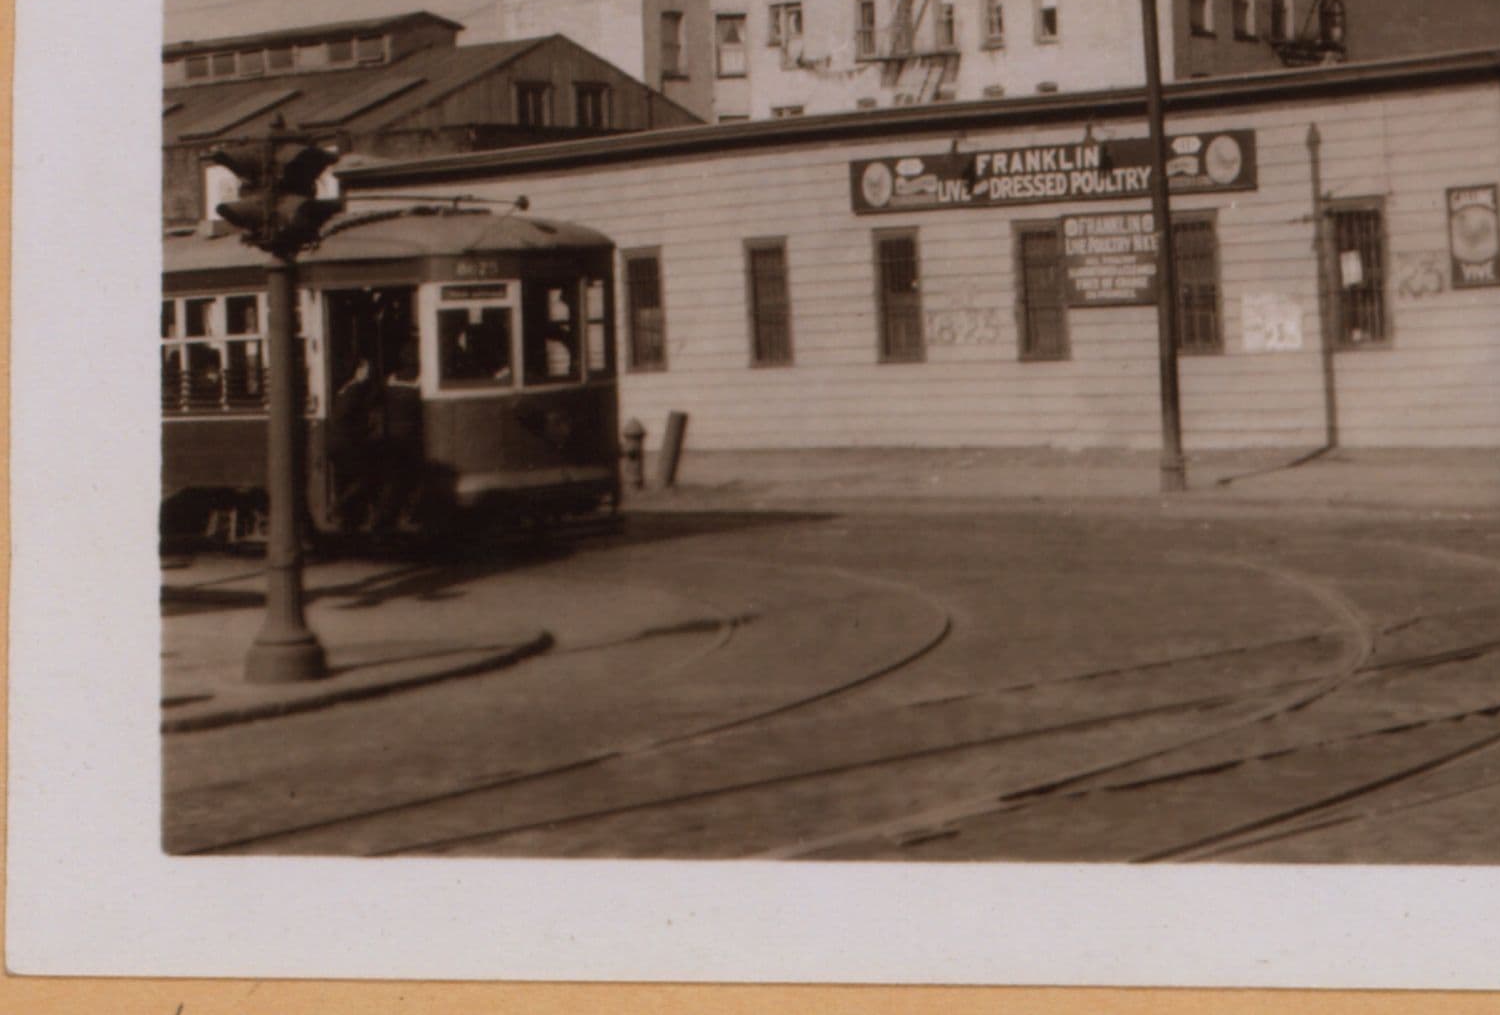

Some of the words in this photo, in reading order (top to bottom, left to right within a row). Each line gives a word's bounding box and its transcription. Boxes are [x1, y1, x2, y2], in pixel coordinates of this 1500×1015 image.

[975, 144, 1100, 177] FRANKLIN
[989, 171, 1068, 200] DRESSED
[1070, 165, 1152, 194] POULTRY
